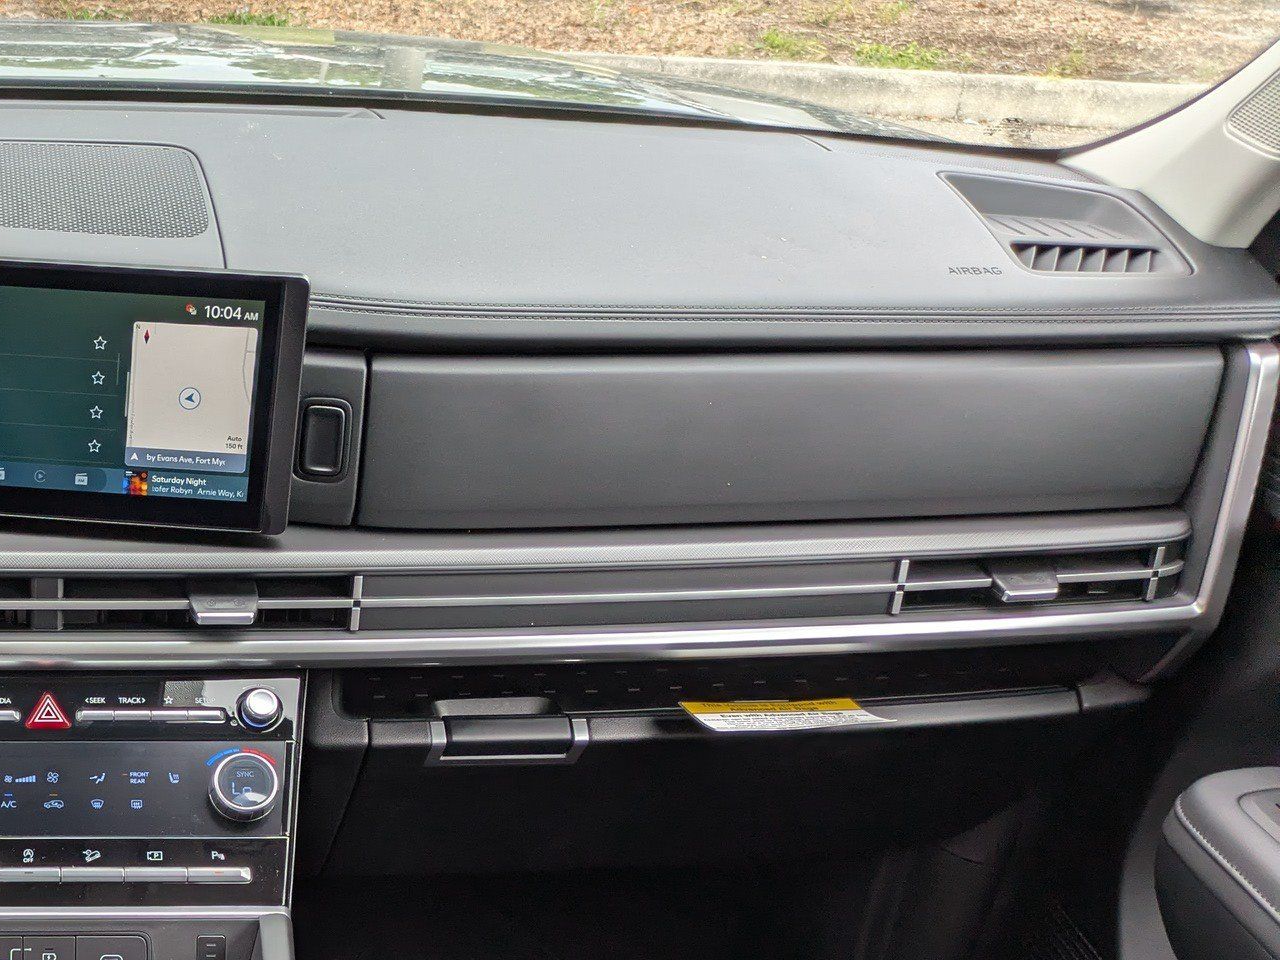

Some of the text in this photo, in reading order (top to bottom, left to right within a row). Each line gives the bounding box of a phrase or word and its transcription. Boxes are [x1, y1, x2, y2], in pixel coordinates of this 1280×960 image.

[947, 266, 1003, 276] AIRBAG
[204, 305, 259, 320] 10:04 AM
[146, 454, 156, 462] by
[157, 454, 178, 462] Evans
[179, 456, 194, 464] Ave,
[196, 457, 210, 465] Fort
[152, 475, 206, 486] Saturday Night
[171, 486, 193, 495] Robyn
[197, 488, 216, 496] Arnie
[236, 770, 254, 778] SYNC
